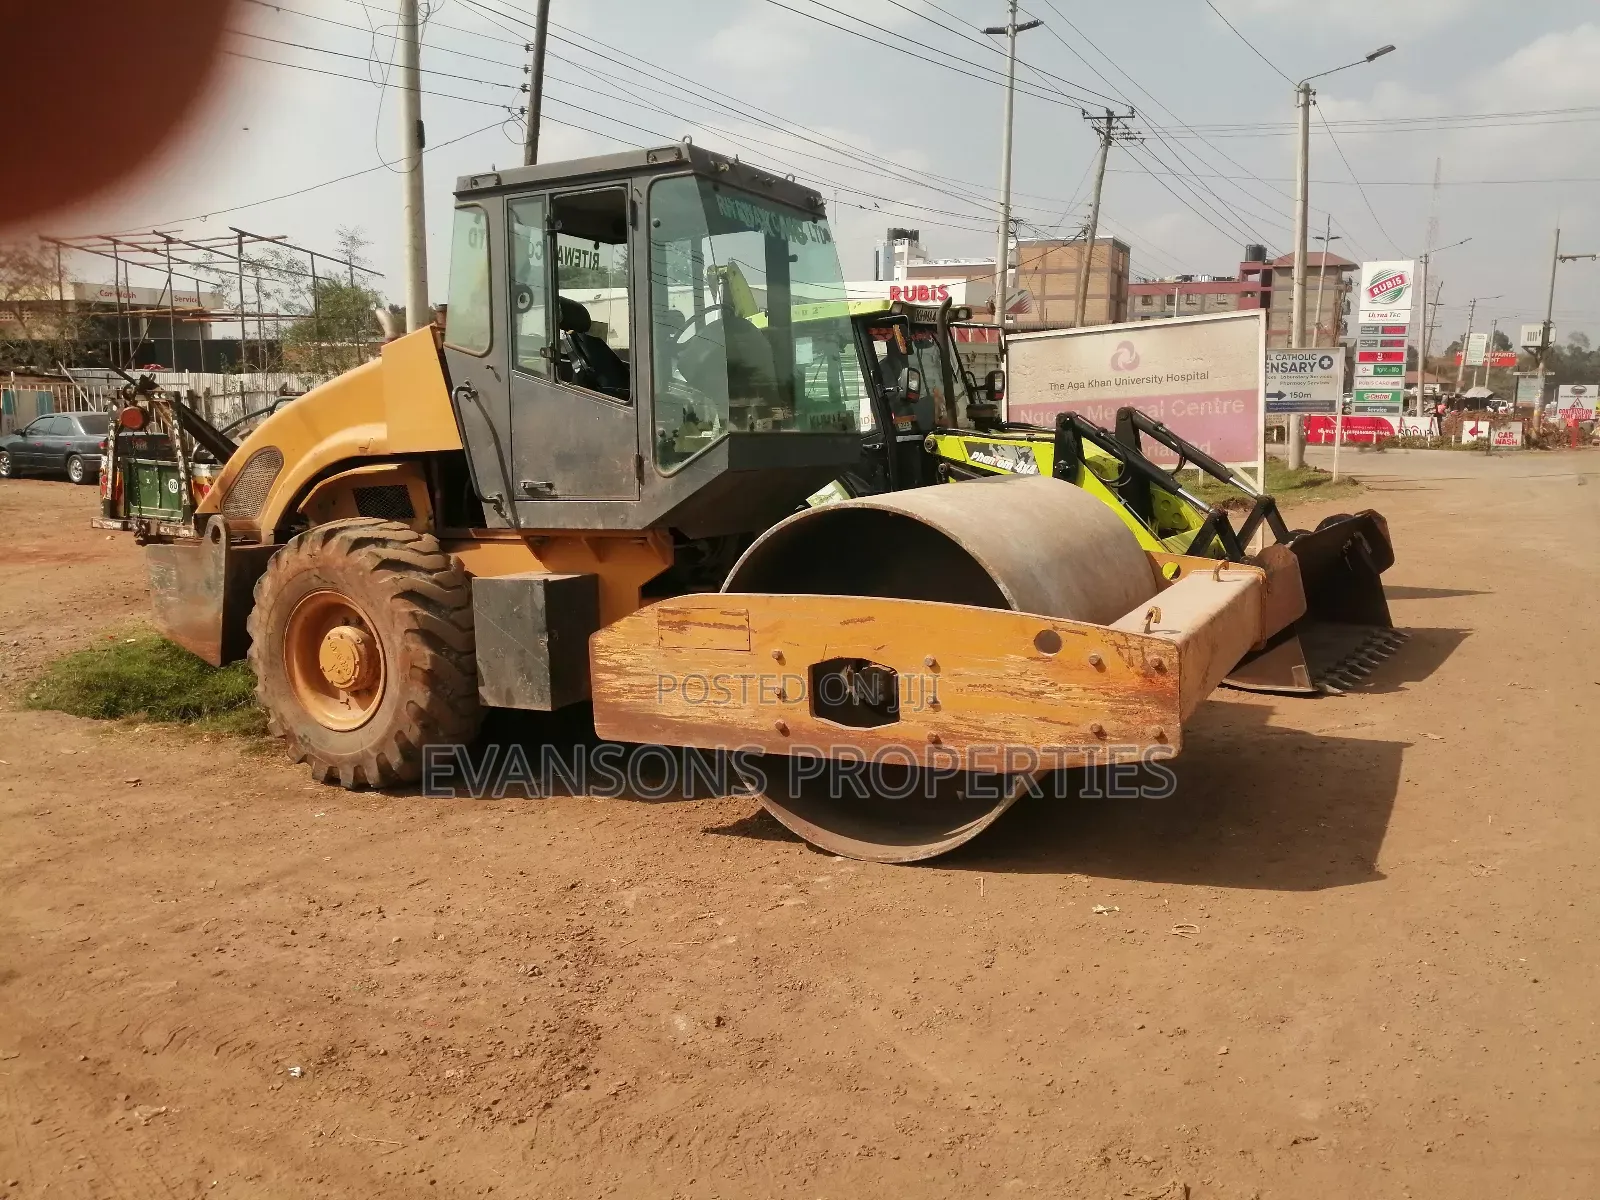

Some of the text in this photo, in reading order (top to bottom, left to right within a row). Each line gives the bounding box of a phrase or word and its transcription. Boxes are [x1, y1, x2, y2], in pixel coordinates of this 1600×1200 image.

[99, 289, 113, 297] Car
[1049, 371, 1209, 391] The Aga Khan University Hospital
[1086, 399, 1164, 421] Mecal
[1171, 397, 1245, 418] Centre
[1497, 431, 1514, 439] CAR
